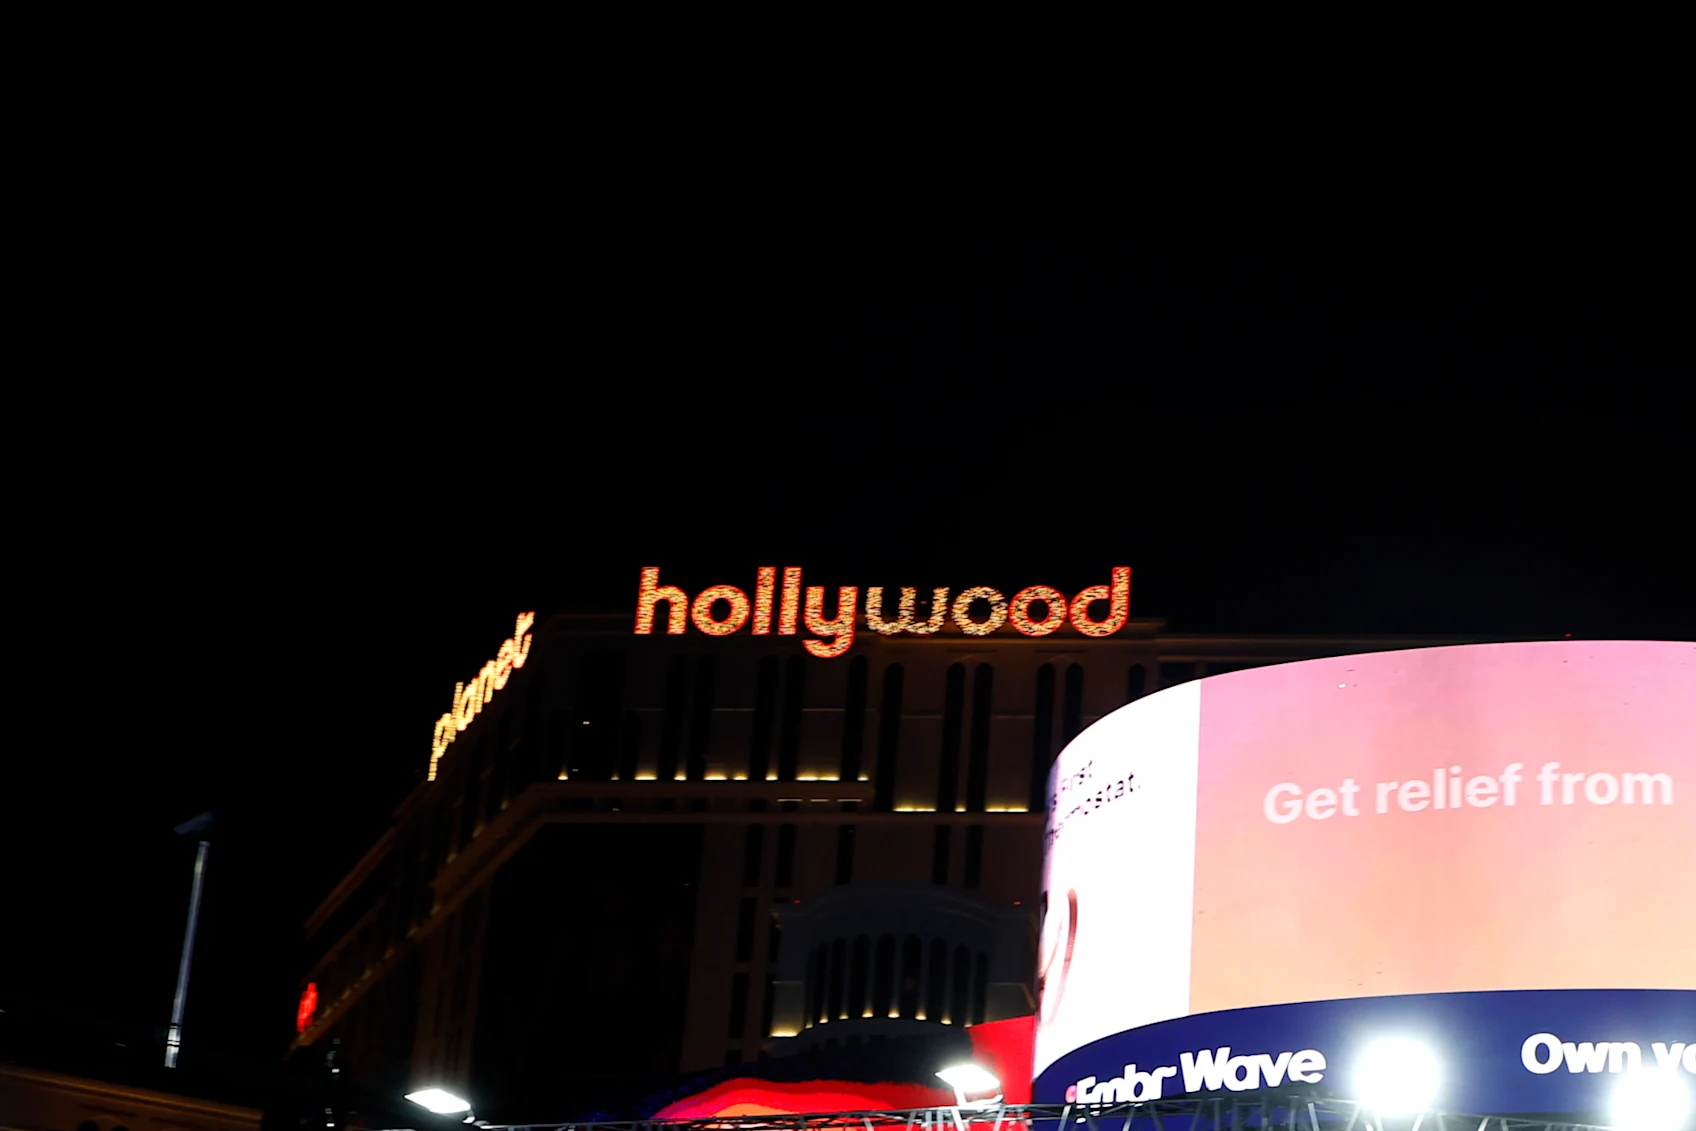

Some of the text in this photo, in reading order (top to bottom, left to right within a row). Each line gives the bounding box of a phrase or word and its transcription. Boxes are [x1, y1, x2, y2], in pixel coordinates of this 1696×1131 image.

[633, 566, 1131, 658] hollywood
[1263, 762, 1674, 824] Get relief from
[1179, 1046, 1327, 1092] Wave
[1521, 1033, 1642, 1074] Own
